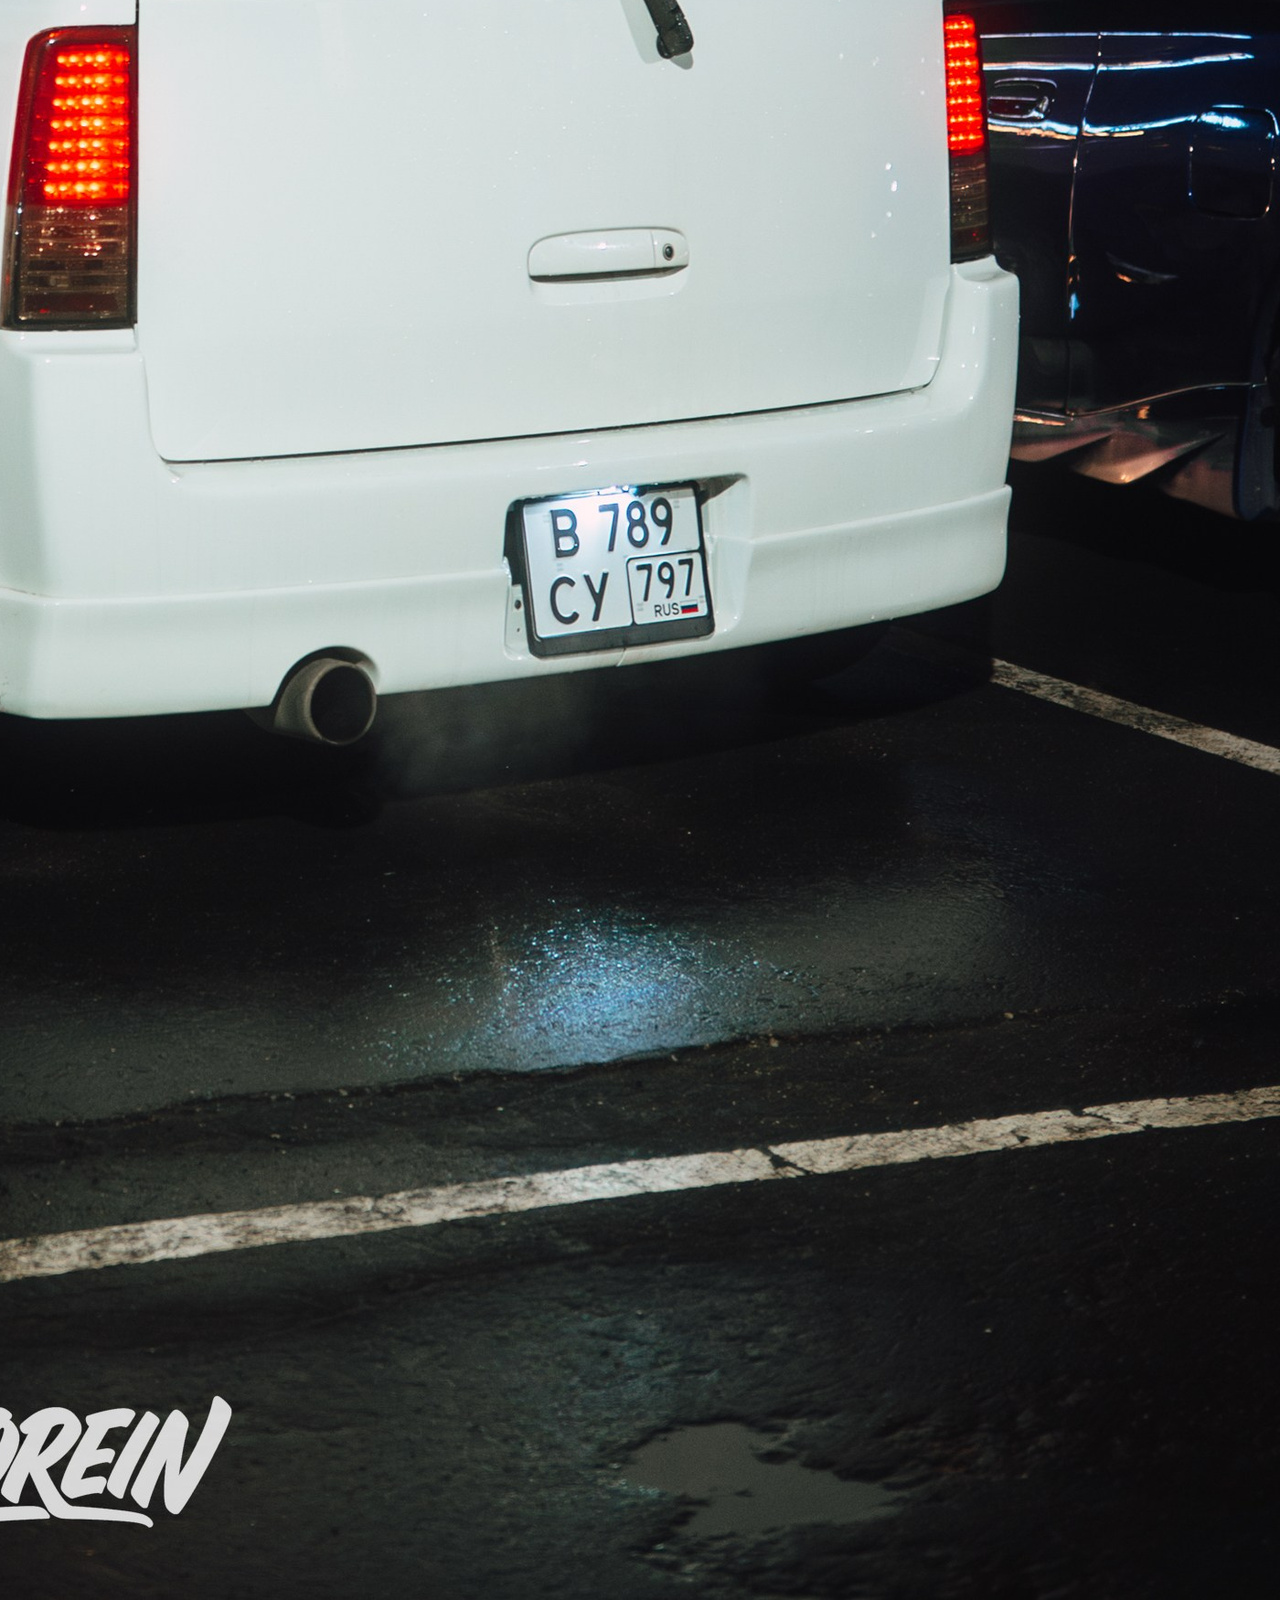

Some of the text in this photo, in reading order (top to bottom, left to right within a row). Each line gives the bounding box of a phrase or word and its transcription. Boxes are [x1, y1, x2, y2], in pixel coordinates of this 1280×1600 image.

[598, 496, 673, 553] 789
[635, 557, 694, 602] 797
[654, 602, 680, 618] RUS
